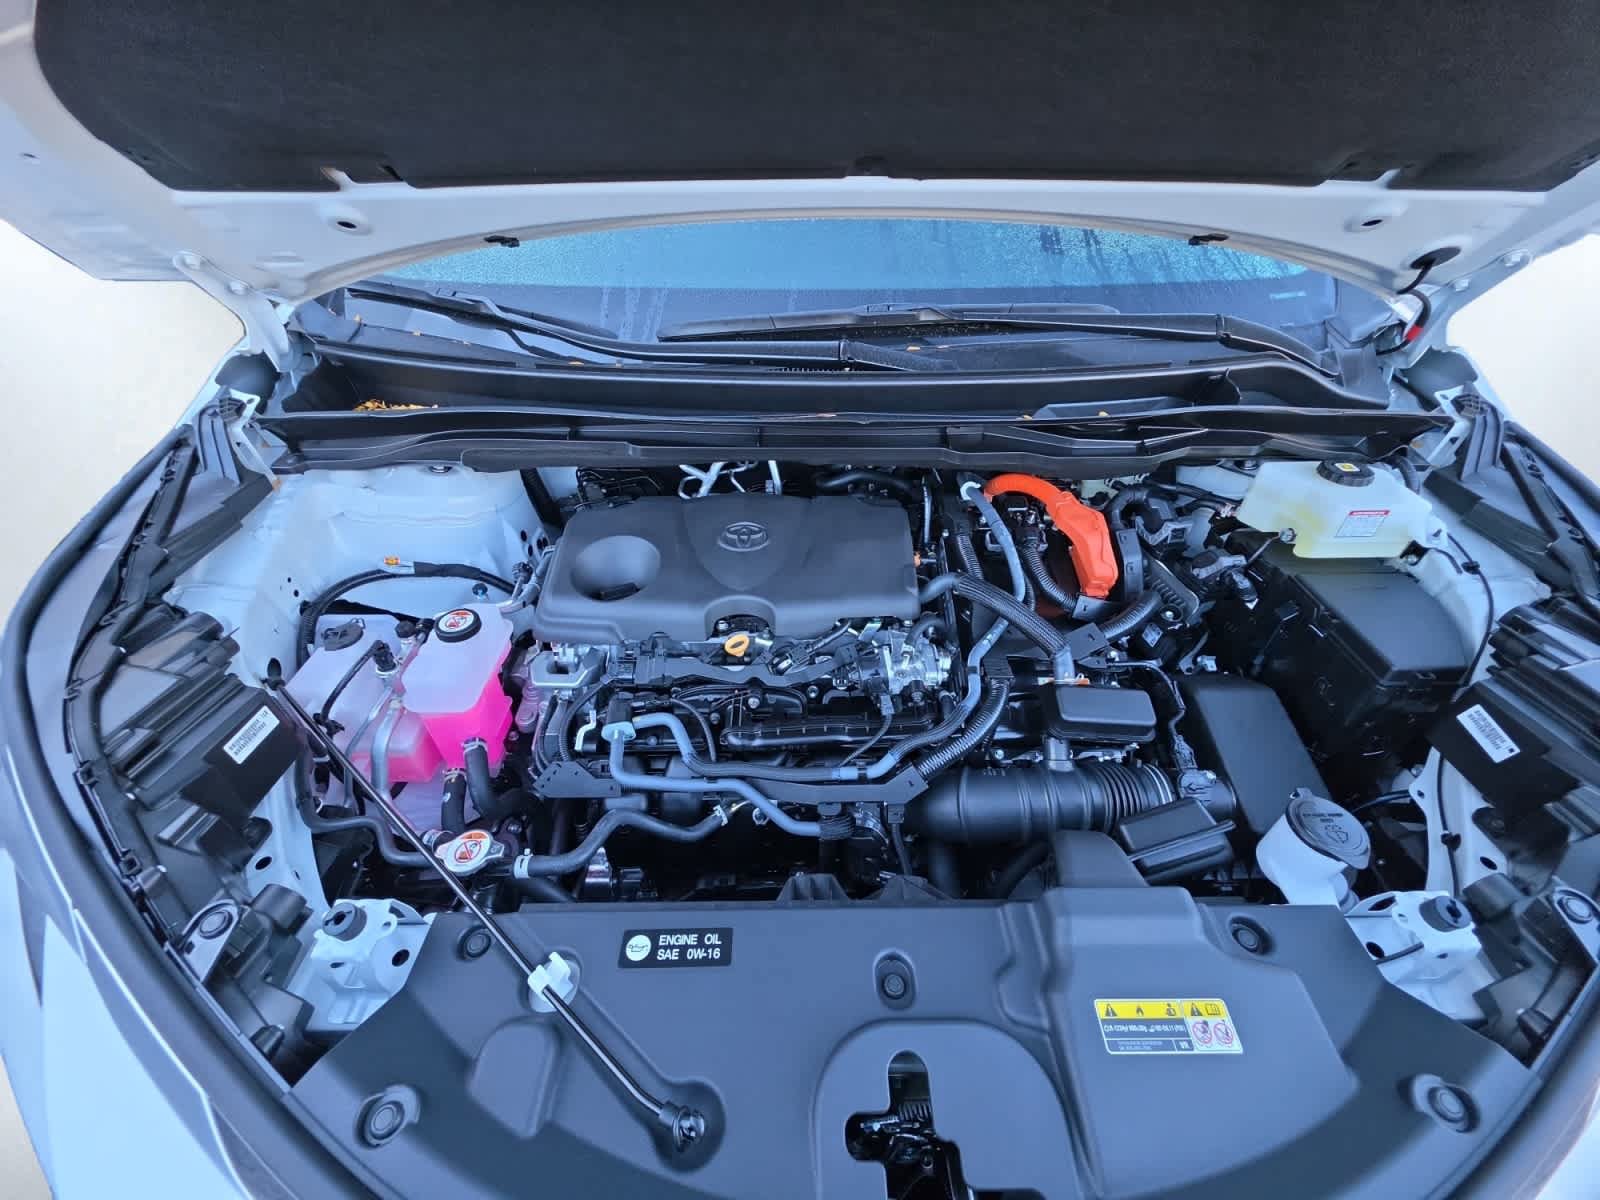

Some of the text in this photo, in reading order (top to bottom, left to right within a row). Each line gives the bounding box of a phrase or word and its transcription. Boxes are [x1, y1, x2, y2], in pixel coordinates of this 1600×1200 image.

[659, 933, 722, 946] ENGINE OIL
[657, 948, 721, 960] SAE 0W-16
